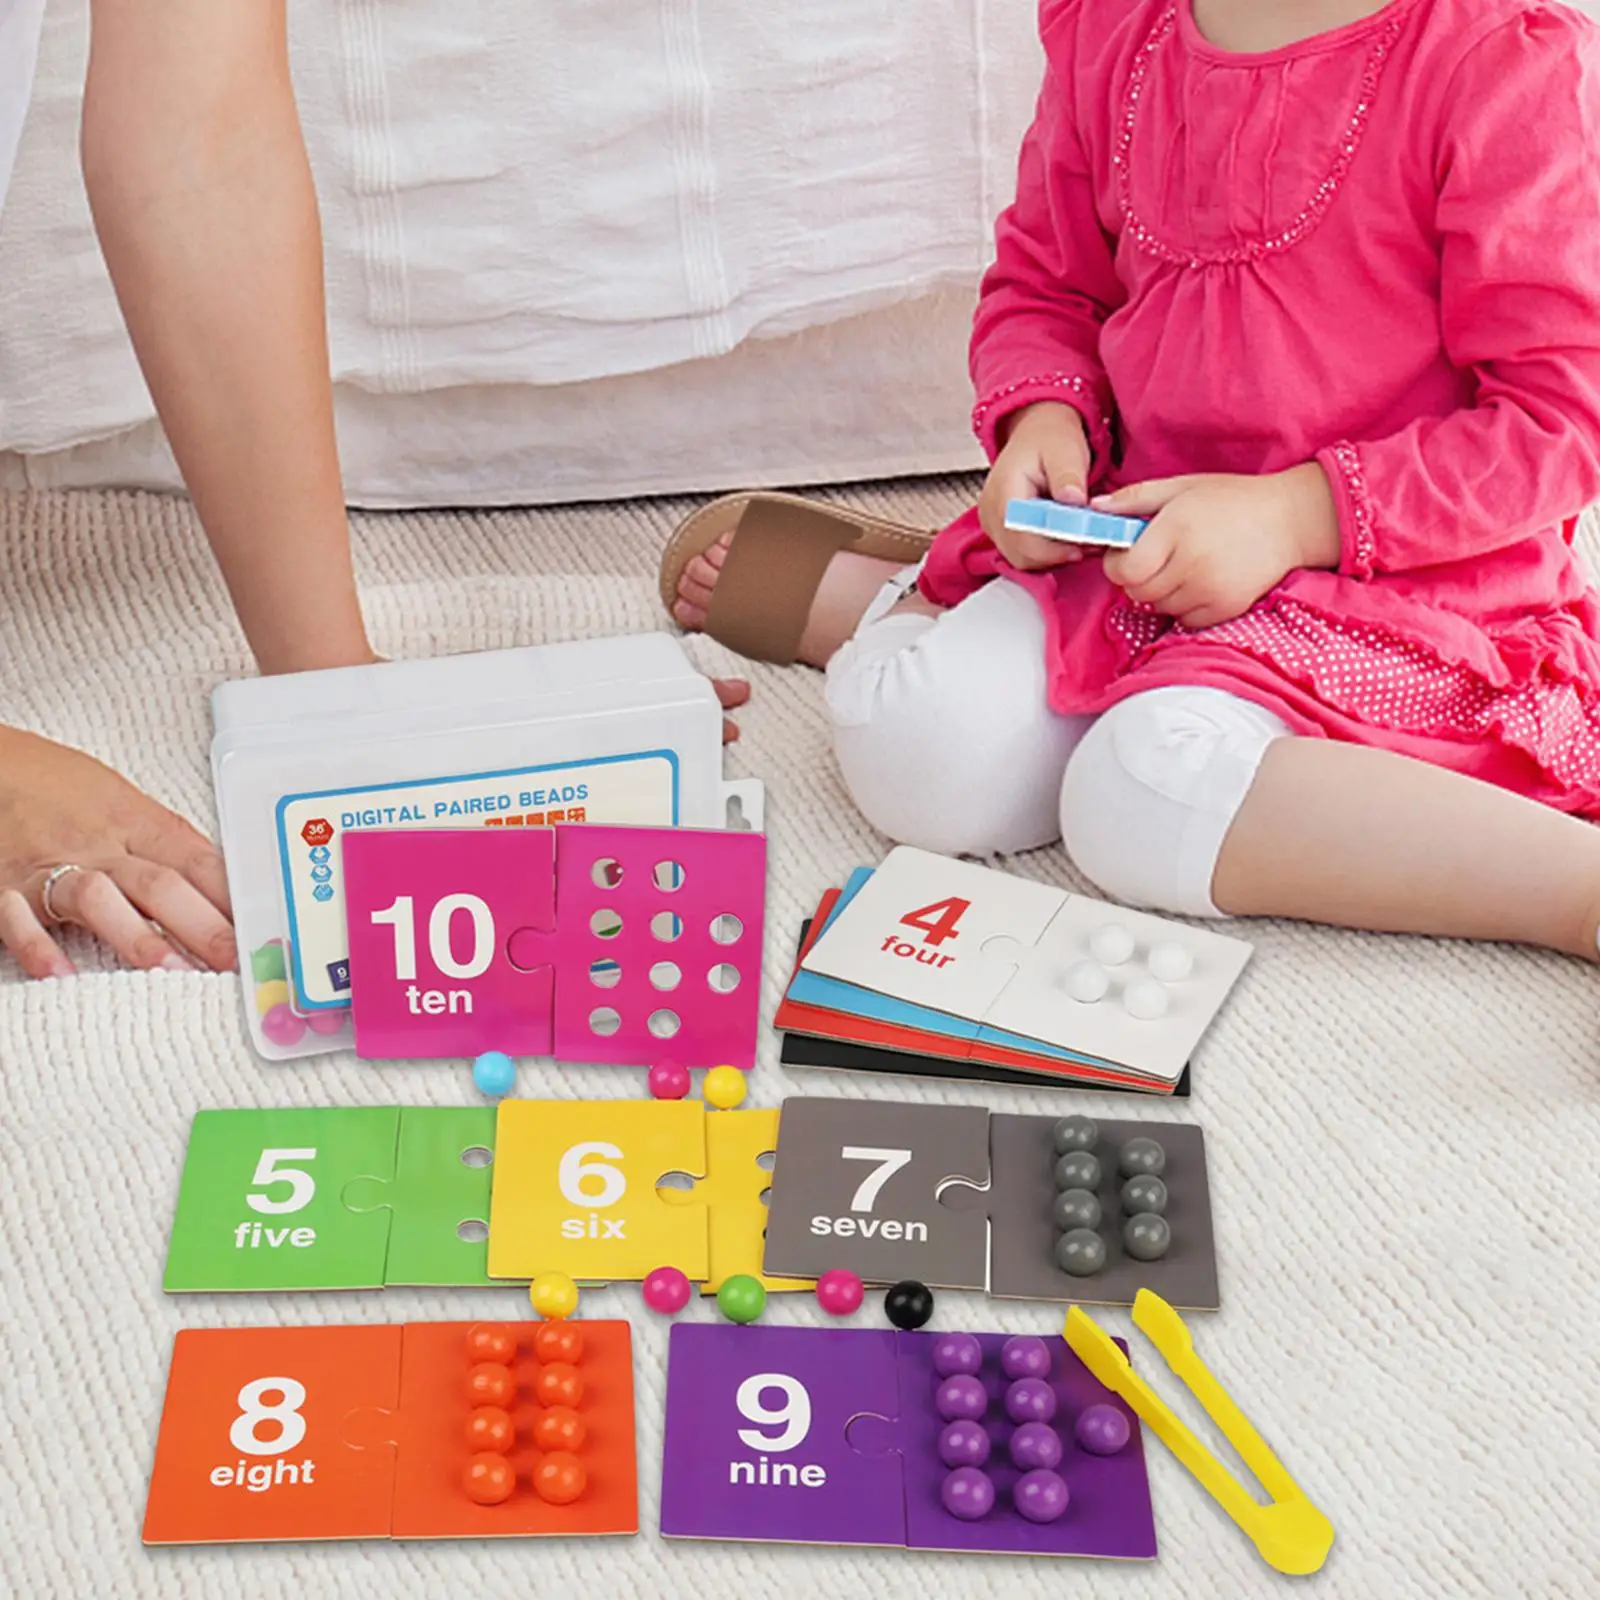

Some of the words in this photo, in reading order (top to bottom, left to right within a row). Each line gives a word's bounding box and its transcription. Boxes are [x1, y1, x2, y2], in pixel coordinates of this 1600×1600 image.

[341, 806, 426, 827] DIGITAL
[434, 795, 512, 817] PAIRED
[519, 784, 589, 807] BEADS
[371, 893, 495, 980] 10
[899, 896, 971, 946] 4
[880, 935, 956, 969] four
[406, 985, 473, 1015] ten
[246, 1148, 317, 1214] 5
[558, 1142, 627, 1208] 6
[840, 1146, 913, 1213] 7
[234, 1222, 316, 1249] five
[561, 1213, 627, 1240] six
[810, 1214, 928, 1242] seven
[229, 1377, 306, 1455] 8
[735, 1373, 812, 1452] 9
[209, 1458, 315, 1492] eight
[729, 1456, 826, 1487] nine
